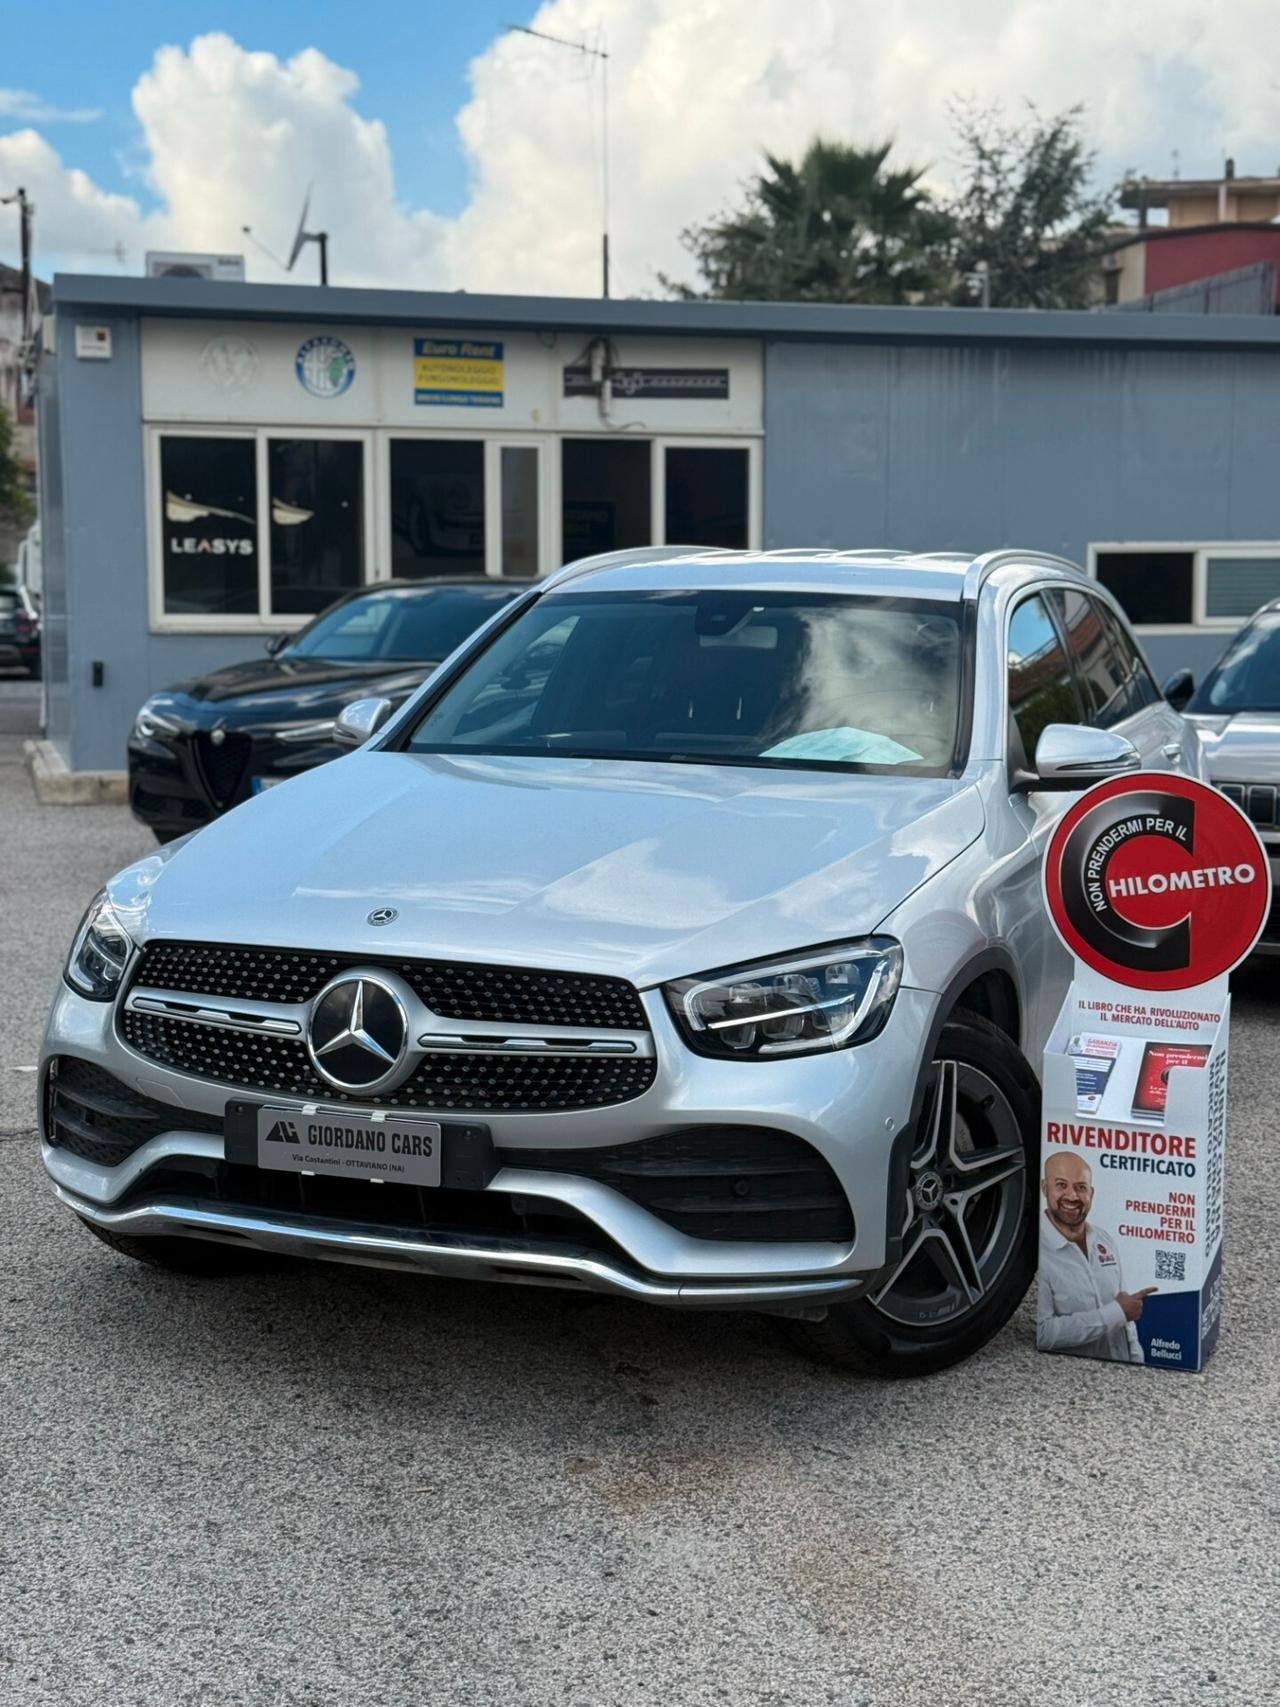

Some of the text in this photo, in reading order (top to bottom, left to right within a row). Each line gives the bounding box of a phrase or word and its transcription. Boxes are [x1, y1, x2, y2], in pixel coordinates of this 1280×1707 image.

[422, 340, 496, 357] Euro Rent
[171, 537, 253, 555] LEASYS
[1088, 817, 1187, 912] NON PRENDERMI PER IL
[1078, 1000, 1221, 1024] IL LIBRO CHE HA RIVOLUZIONATO
[1100, 1013, 1200, 1031] IL MERCATO DELL'AUTO
[308, 1124, 386, 1153] GIORDANO
[391, 1133, 433, 1157] CARS
[1047, 1121, 1196, 1159] RIVENDITORE
[292, 1153, 303, 1162] Via
[304, 1155, 341, 1166] Costantini
[345, 1159, 388, 1171] OTTAVIANO
[389, 1164, 405, 1173] (NA)
[1100, 1153, 1196, 1178] CERTIFICATO
[1168, 1192, 1196, 1206] NON
[1125, 1200, 1196, 1218] PRENDERMI
[1160, 1216, 1196, 1231] PER IL
[1118, 1225, 1196, 1244] CHILOMETRO
[1150, 1338, 1180, 1350] Alfredo
[1150, 1348, 1182, 1360] Bellucci
